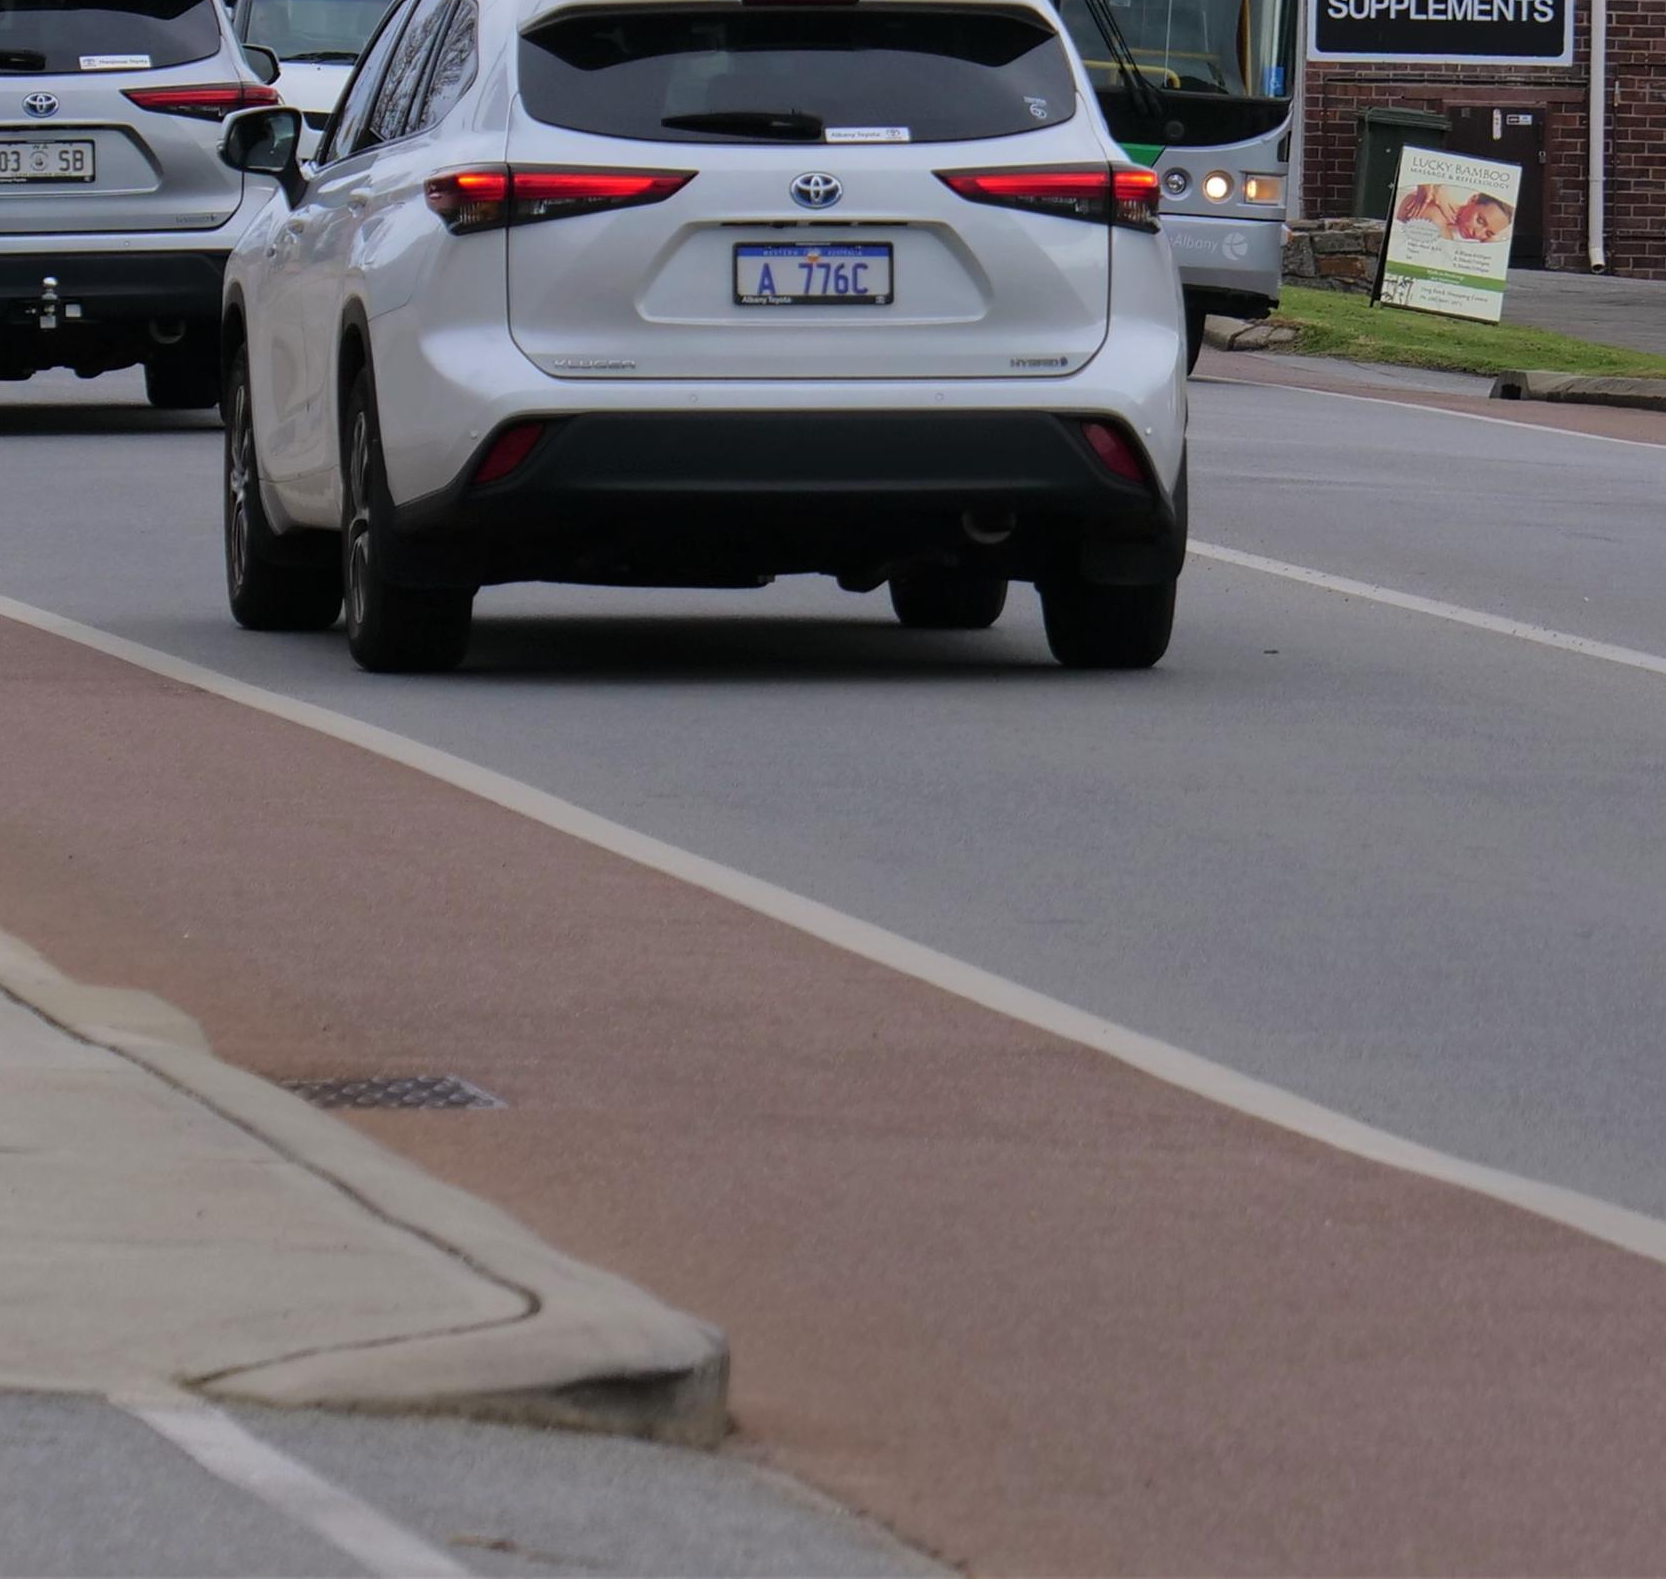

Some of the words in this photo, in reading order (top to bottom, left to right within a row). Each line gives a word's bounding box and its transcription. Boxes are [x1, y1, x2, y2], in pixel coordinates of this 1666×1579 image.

[1411, 156, 1452, 172] LUCKY
[1455, 163, 1510, 182] BAMBOO
[757, 262, 776, 295] A
[798, 262, 869, 295] 776C
